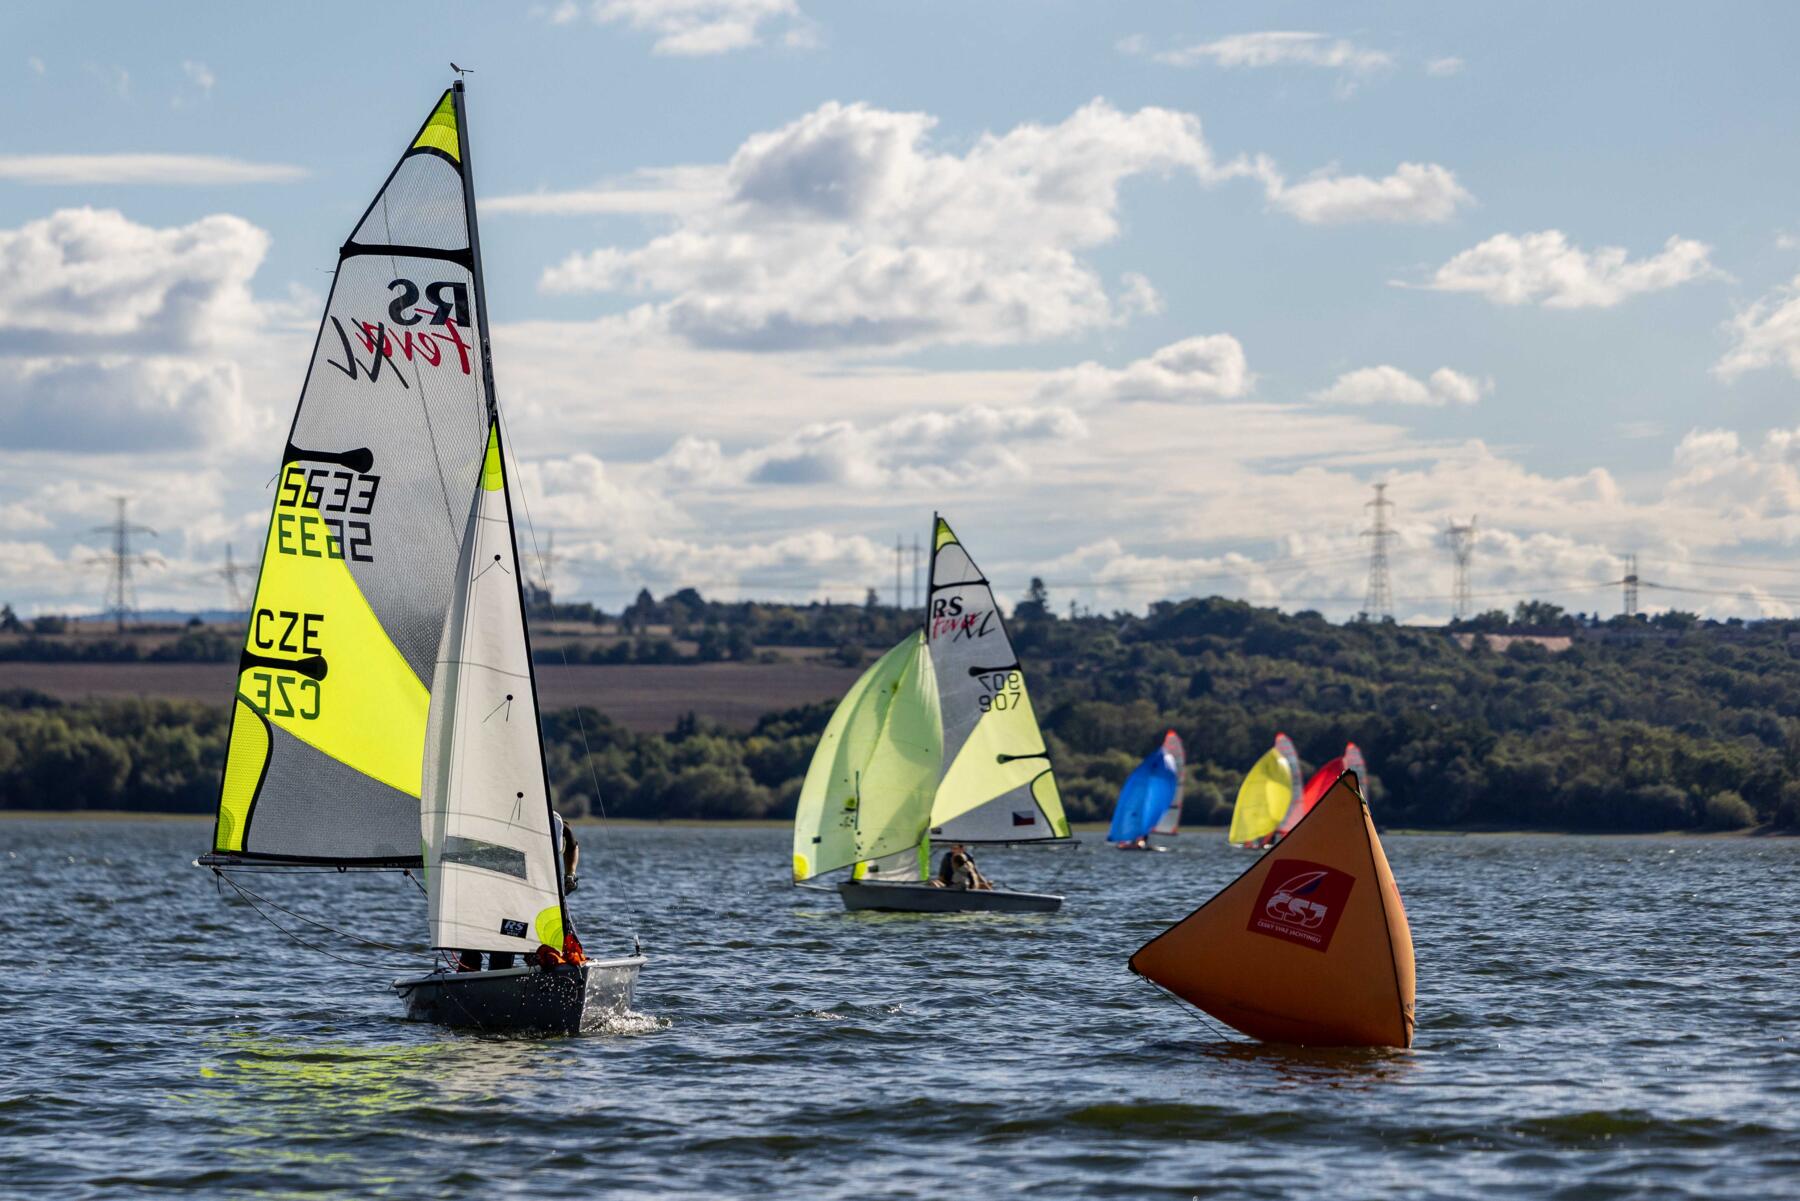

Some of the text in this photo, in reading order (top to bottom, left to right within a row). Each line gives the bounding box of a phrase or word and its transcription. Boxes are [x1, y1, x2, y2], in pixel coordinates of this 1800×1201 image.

[280, 467, 381, 515] 5633
[933, 596, 964, 619] RS
[255, 608, 324, 656] CZE
[978, 692, 1021, 713] 907
[504, 920, 525, 931] RS
